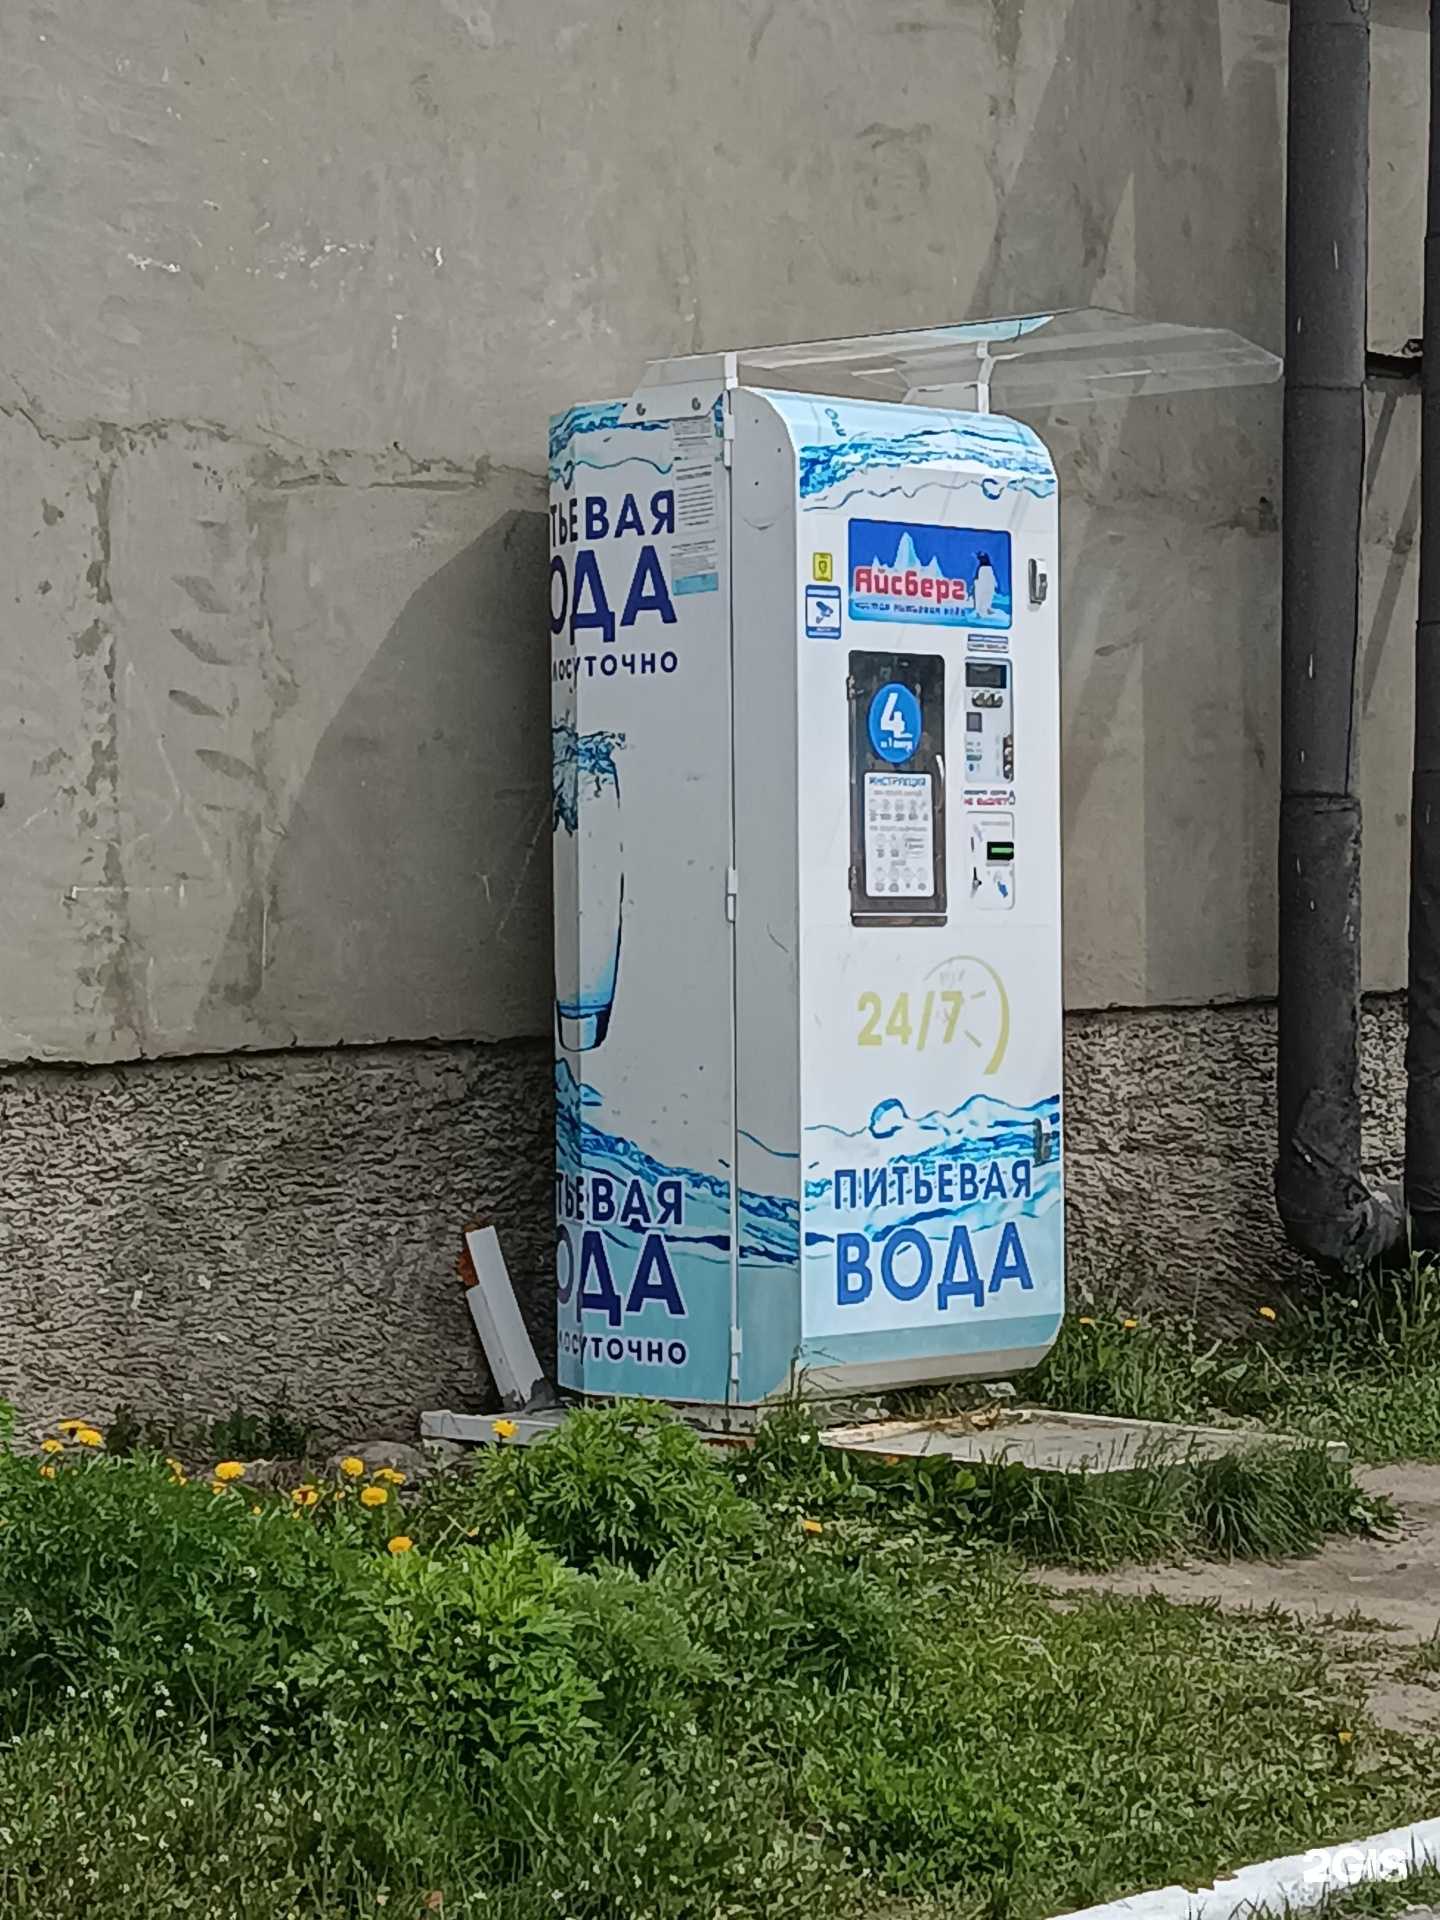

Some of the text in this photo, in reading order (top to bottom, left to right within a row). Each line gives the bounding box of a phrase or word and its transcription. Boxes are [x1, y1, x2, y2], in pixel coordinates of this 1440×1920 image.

[881, 693, 905, 738] 4
[857, 991, 964, 1051] 24/7
[834, 1159, 1032, 1210] ПИТЬЕВАЯ
[836, 1221, 1034, 1311] ВОДА
